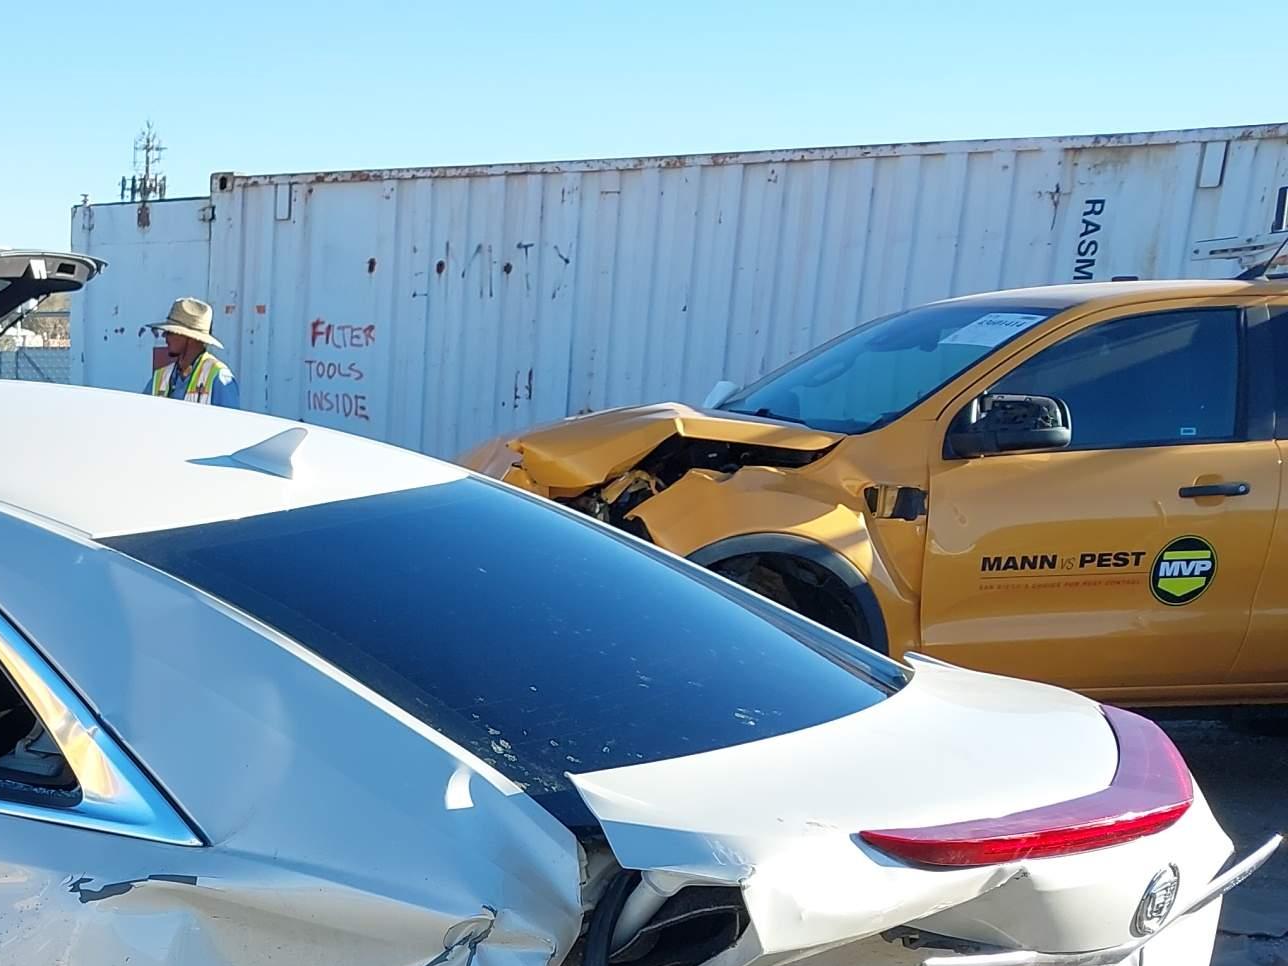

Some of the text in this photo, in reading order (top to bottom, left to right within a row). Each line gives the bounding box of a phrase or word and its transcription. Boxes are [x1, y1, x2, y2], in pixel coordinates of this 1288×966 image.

[1073, 199, 1106, 280] RASM
[311, 318, 375, 349] FILTER
[304, 360, 364, 384] TOOLS
[307, 390, 369, 420] INSIDE
[981, 554, 1057, 572] MANN
[1079, 551, 1146, 569] PEST
[1158, 559, 1213, 577] MVP
